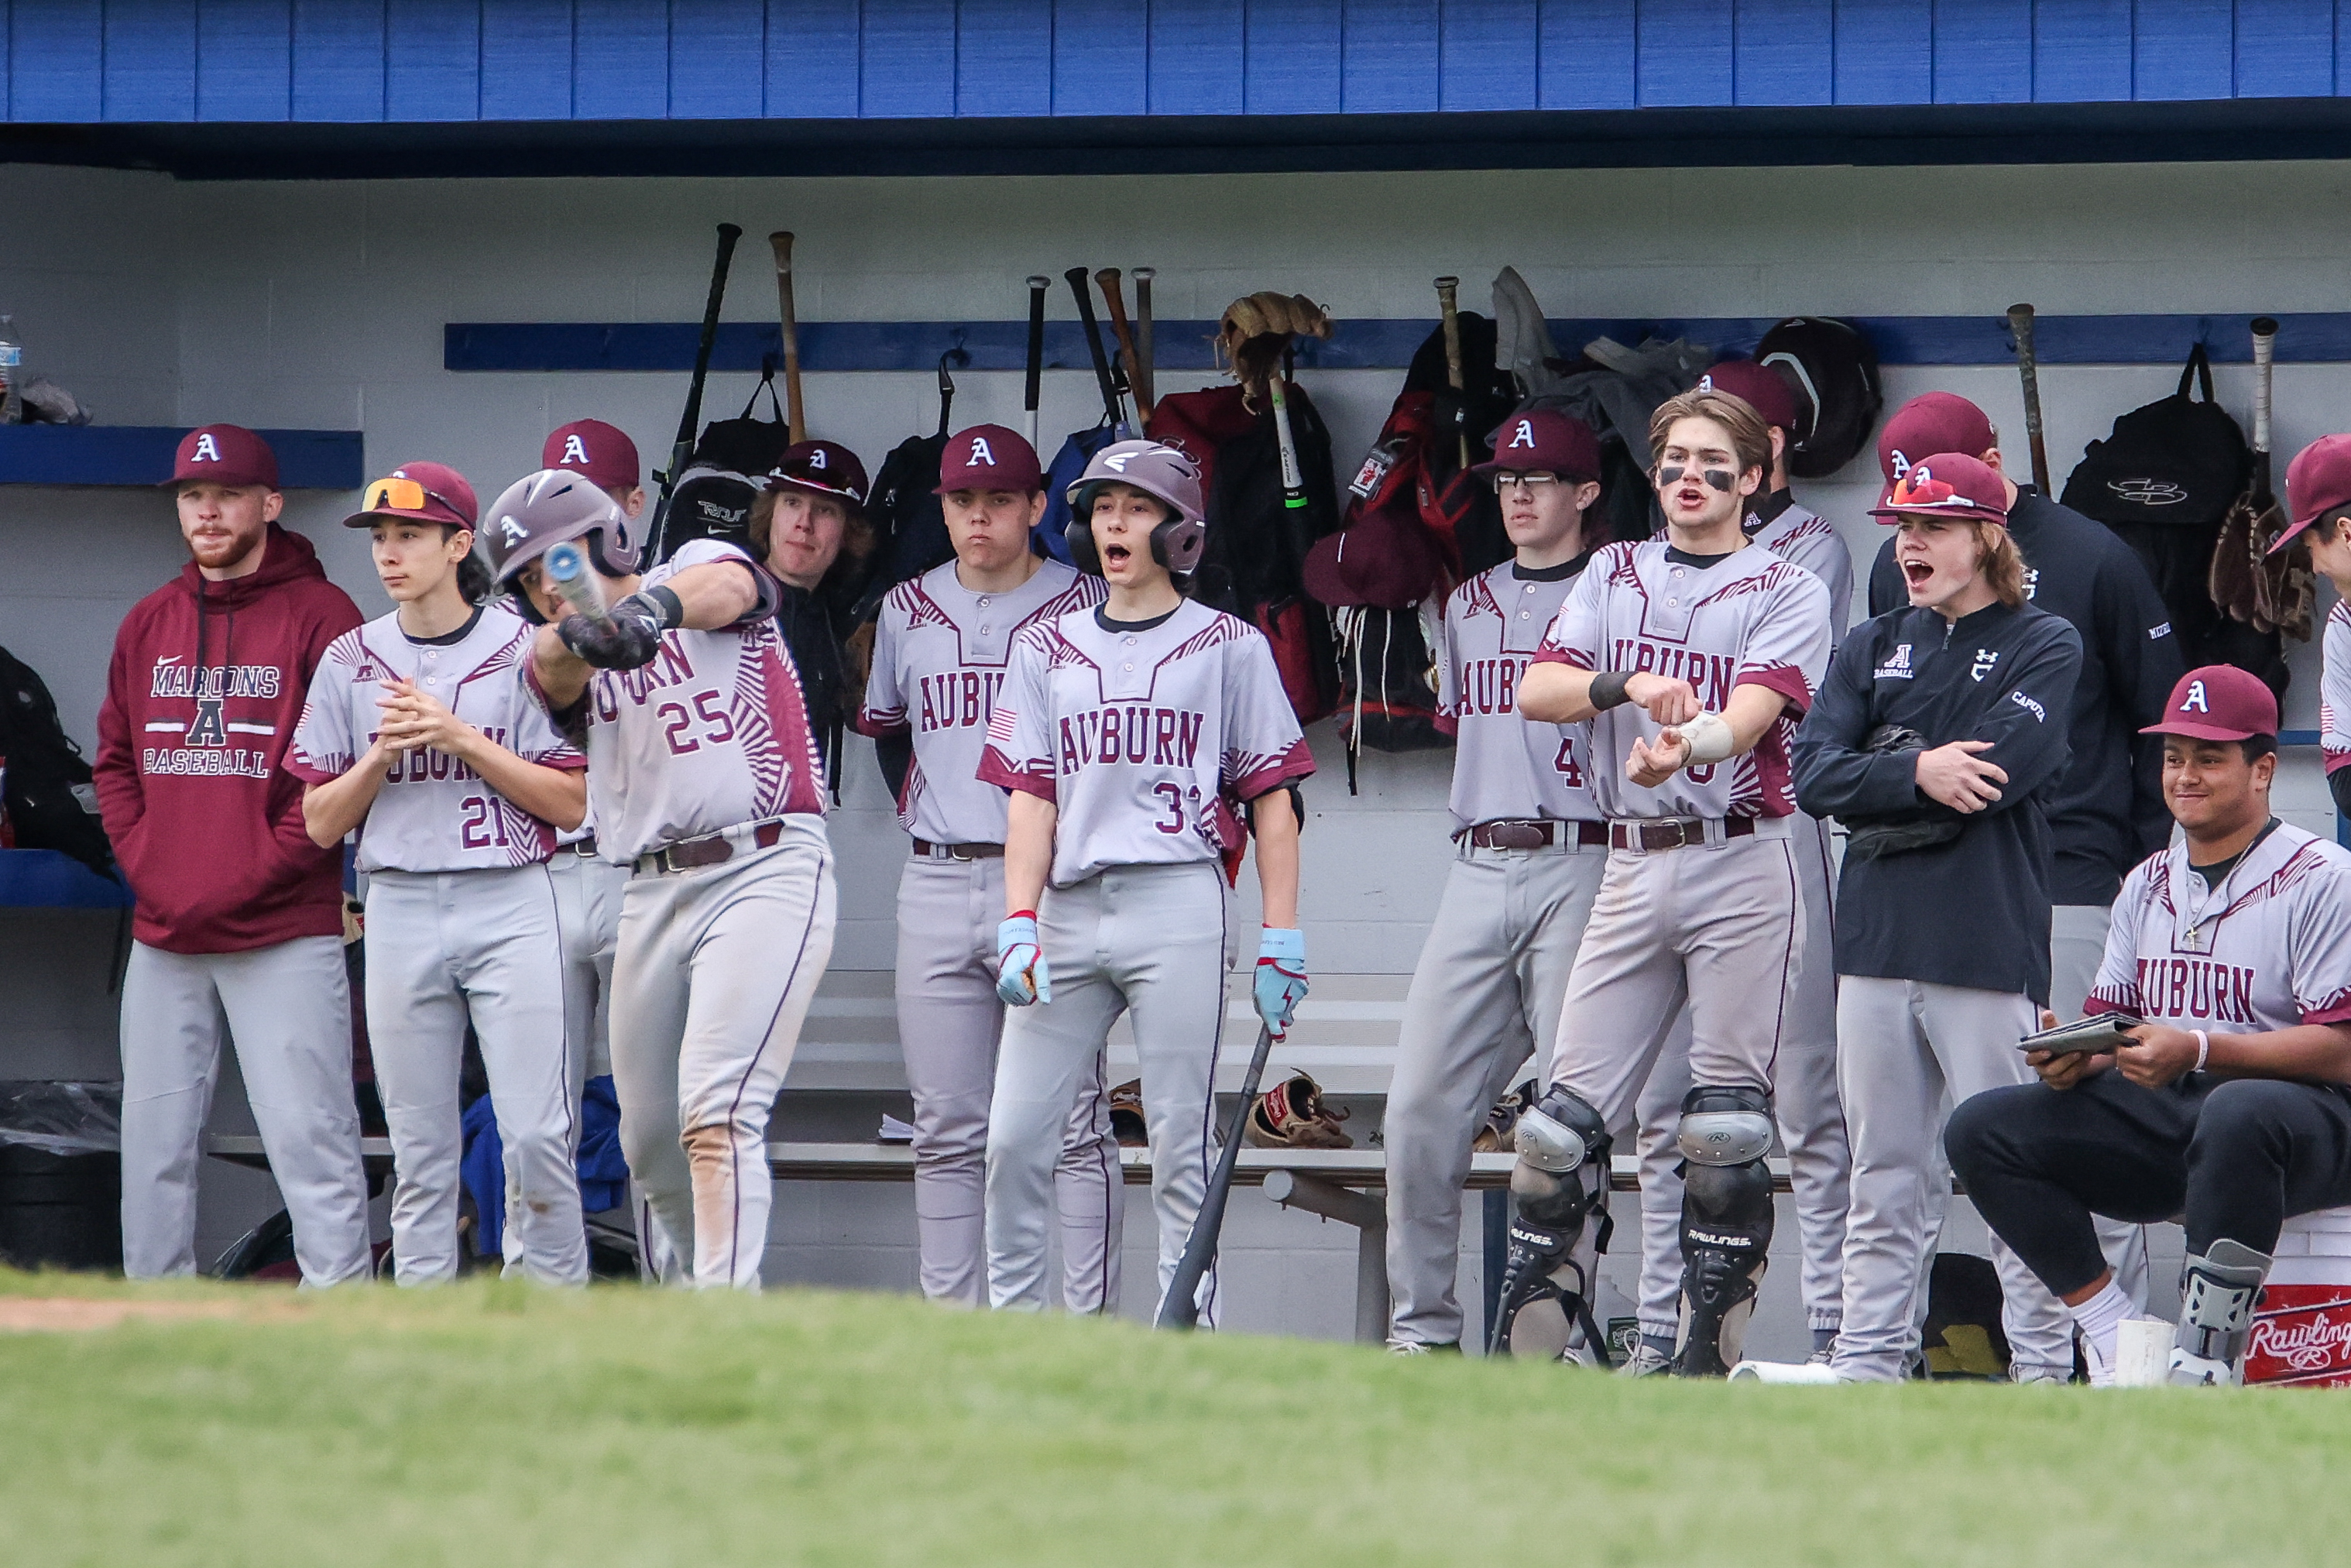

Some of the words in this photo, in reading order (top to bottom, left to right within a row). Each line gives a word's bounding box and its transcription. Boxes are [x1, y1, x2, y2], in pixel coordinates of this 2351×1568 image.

[190, 433, 221, 461] A
[559, 434, 590, 464] A
[1508, 420, 1536, 448] A
[966, 437, 997, 466] A
[500, 515, 528, 548] A
[1744, 511, 1762, 527] A
[1883, 643, 1912, 668] A
[150, 665, 280, 698] MAROONS
[1458, 657, 1530, 717] AUB
[1613, 636, 1737, 714] UBURN
[1872, 667, 1913, 679] BASEBALL
[2011, 691, 2046, 723] CAPUTA
[2179, 680, 2209, 713] A
[184, 698, 228, 746] A
[657, 688, 736, 757] 25
[1059, 705, 1204, 777] AUBURN
[143, 748, 269, 779] BASEBALL
[460, 795, 510, 851] 21
[2136, 956, 2259, 1026] AUBURN
[1688, 1229, 1752, 1247] RAWLINGS
